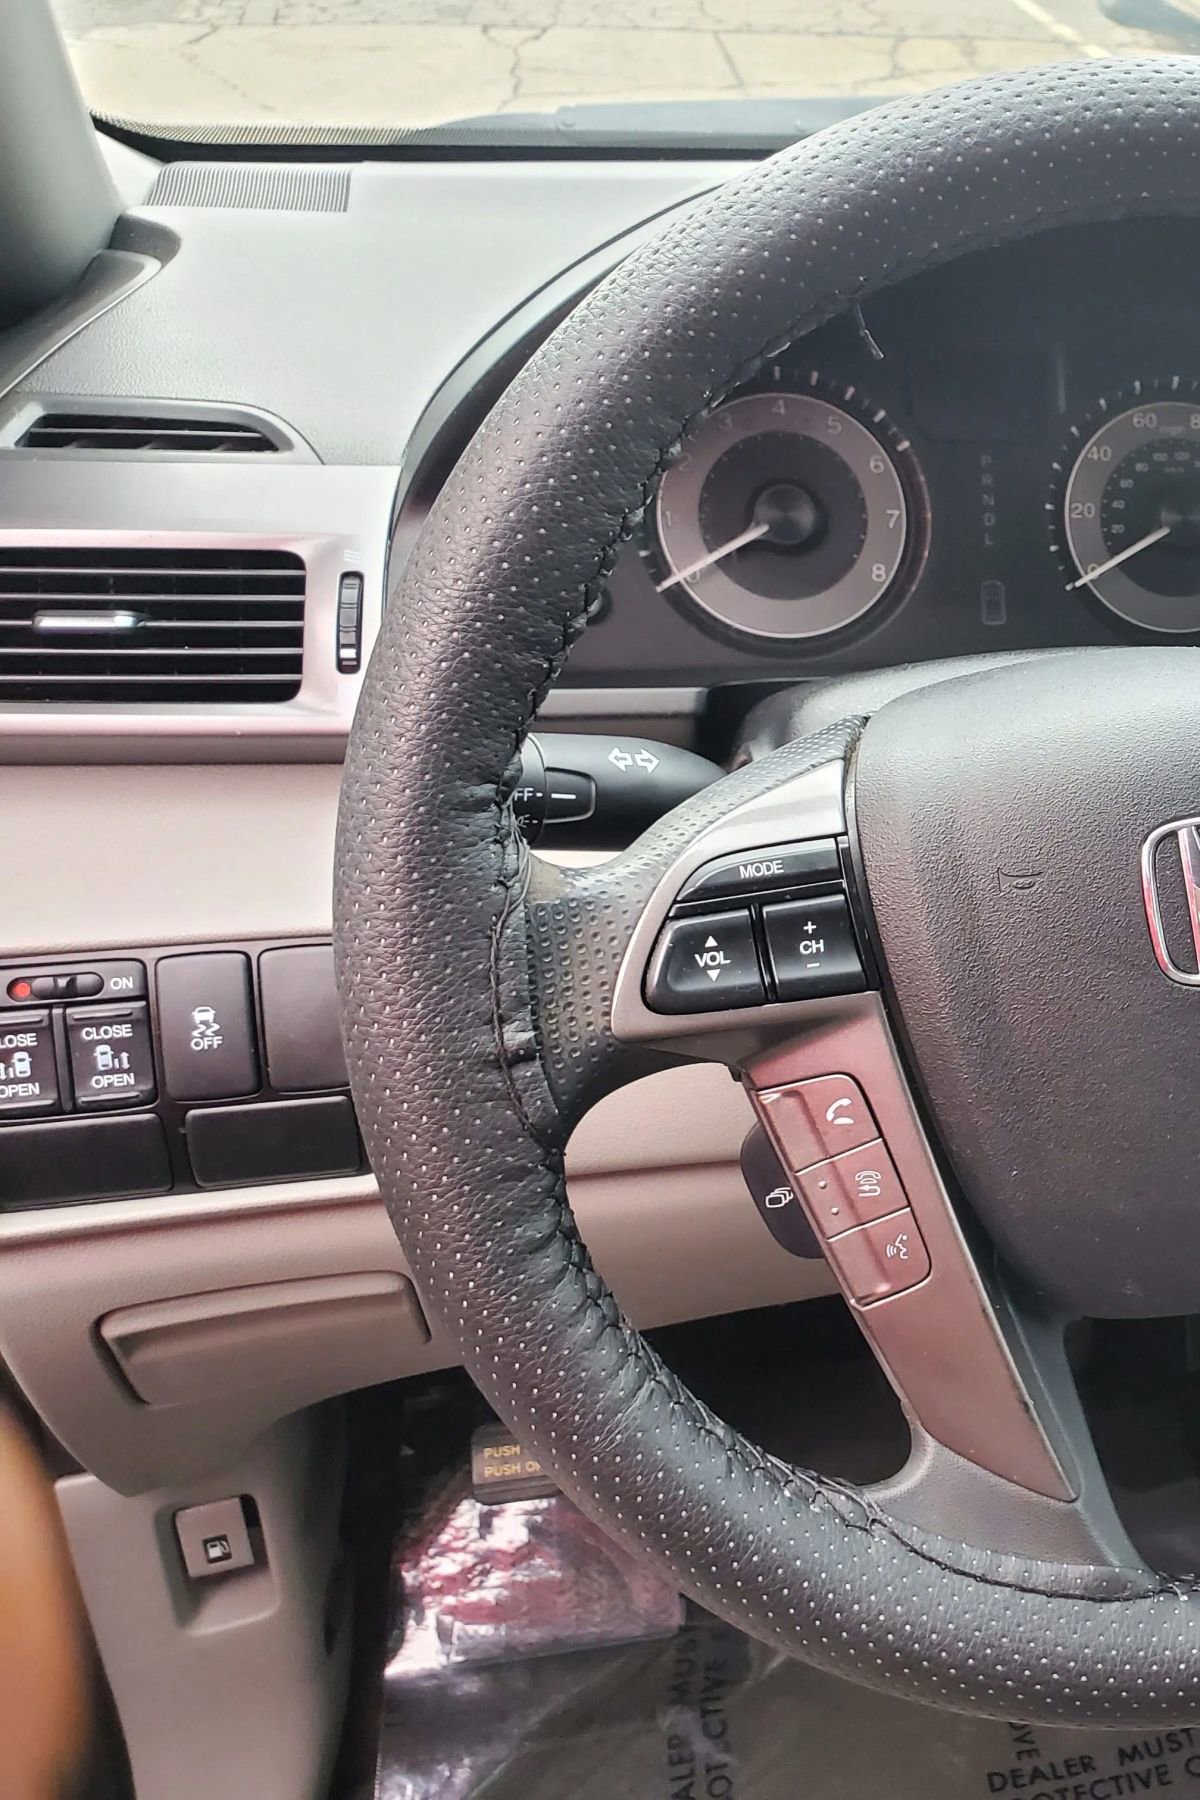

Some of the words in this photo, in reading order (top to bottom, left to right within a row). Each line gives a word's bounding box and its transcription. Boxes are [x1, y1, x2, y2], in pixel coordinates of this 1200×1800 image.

[828, 416, 842, 434] 5
[1132, 413, 1157, 429] 60
[1087, 446, 1112, 461] 40
[869, 456, 885, 473] 6
[1071, 503, 1095, 518] 20
[885, 510, 900, 528] 7
[871, 564, 887, 582] 8
[514, 787, 534, 801] FF
[739, 860, 784, 878] MODE
[799, 939, 825, 955] CH
[694, 952, 731, 967] VOL
[110, 977, 134, 990] ON
[82, 1023, 133, 1041] CLOSE
[0, 1033, 38, 1049] LOSE
[190, 1036, 223, 1051] OFF
[91, 1072, 136, 1089] OPEN
[0, 1082, 41, 1099] OPEN
[483, 1445, 521, 1459] PUSH
[484, 1462, 521, 1477] PUSH
[986, 1754, 1097, 1793] DEALER
[1117, 1727, 1196, 1767] MUST
